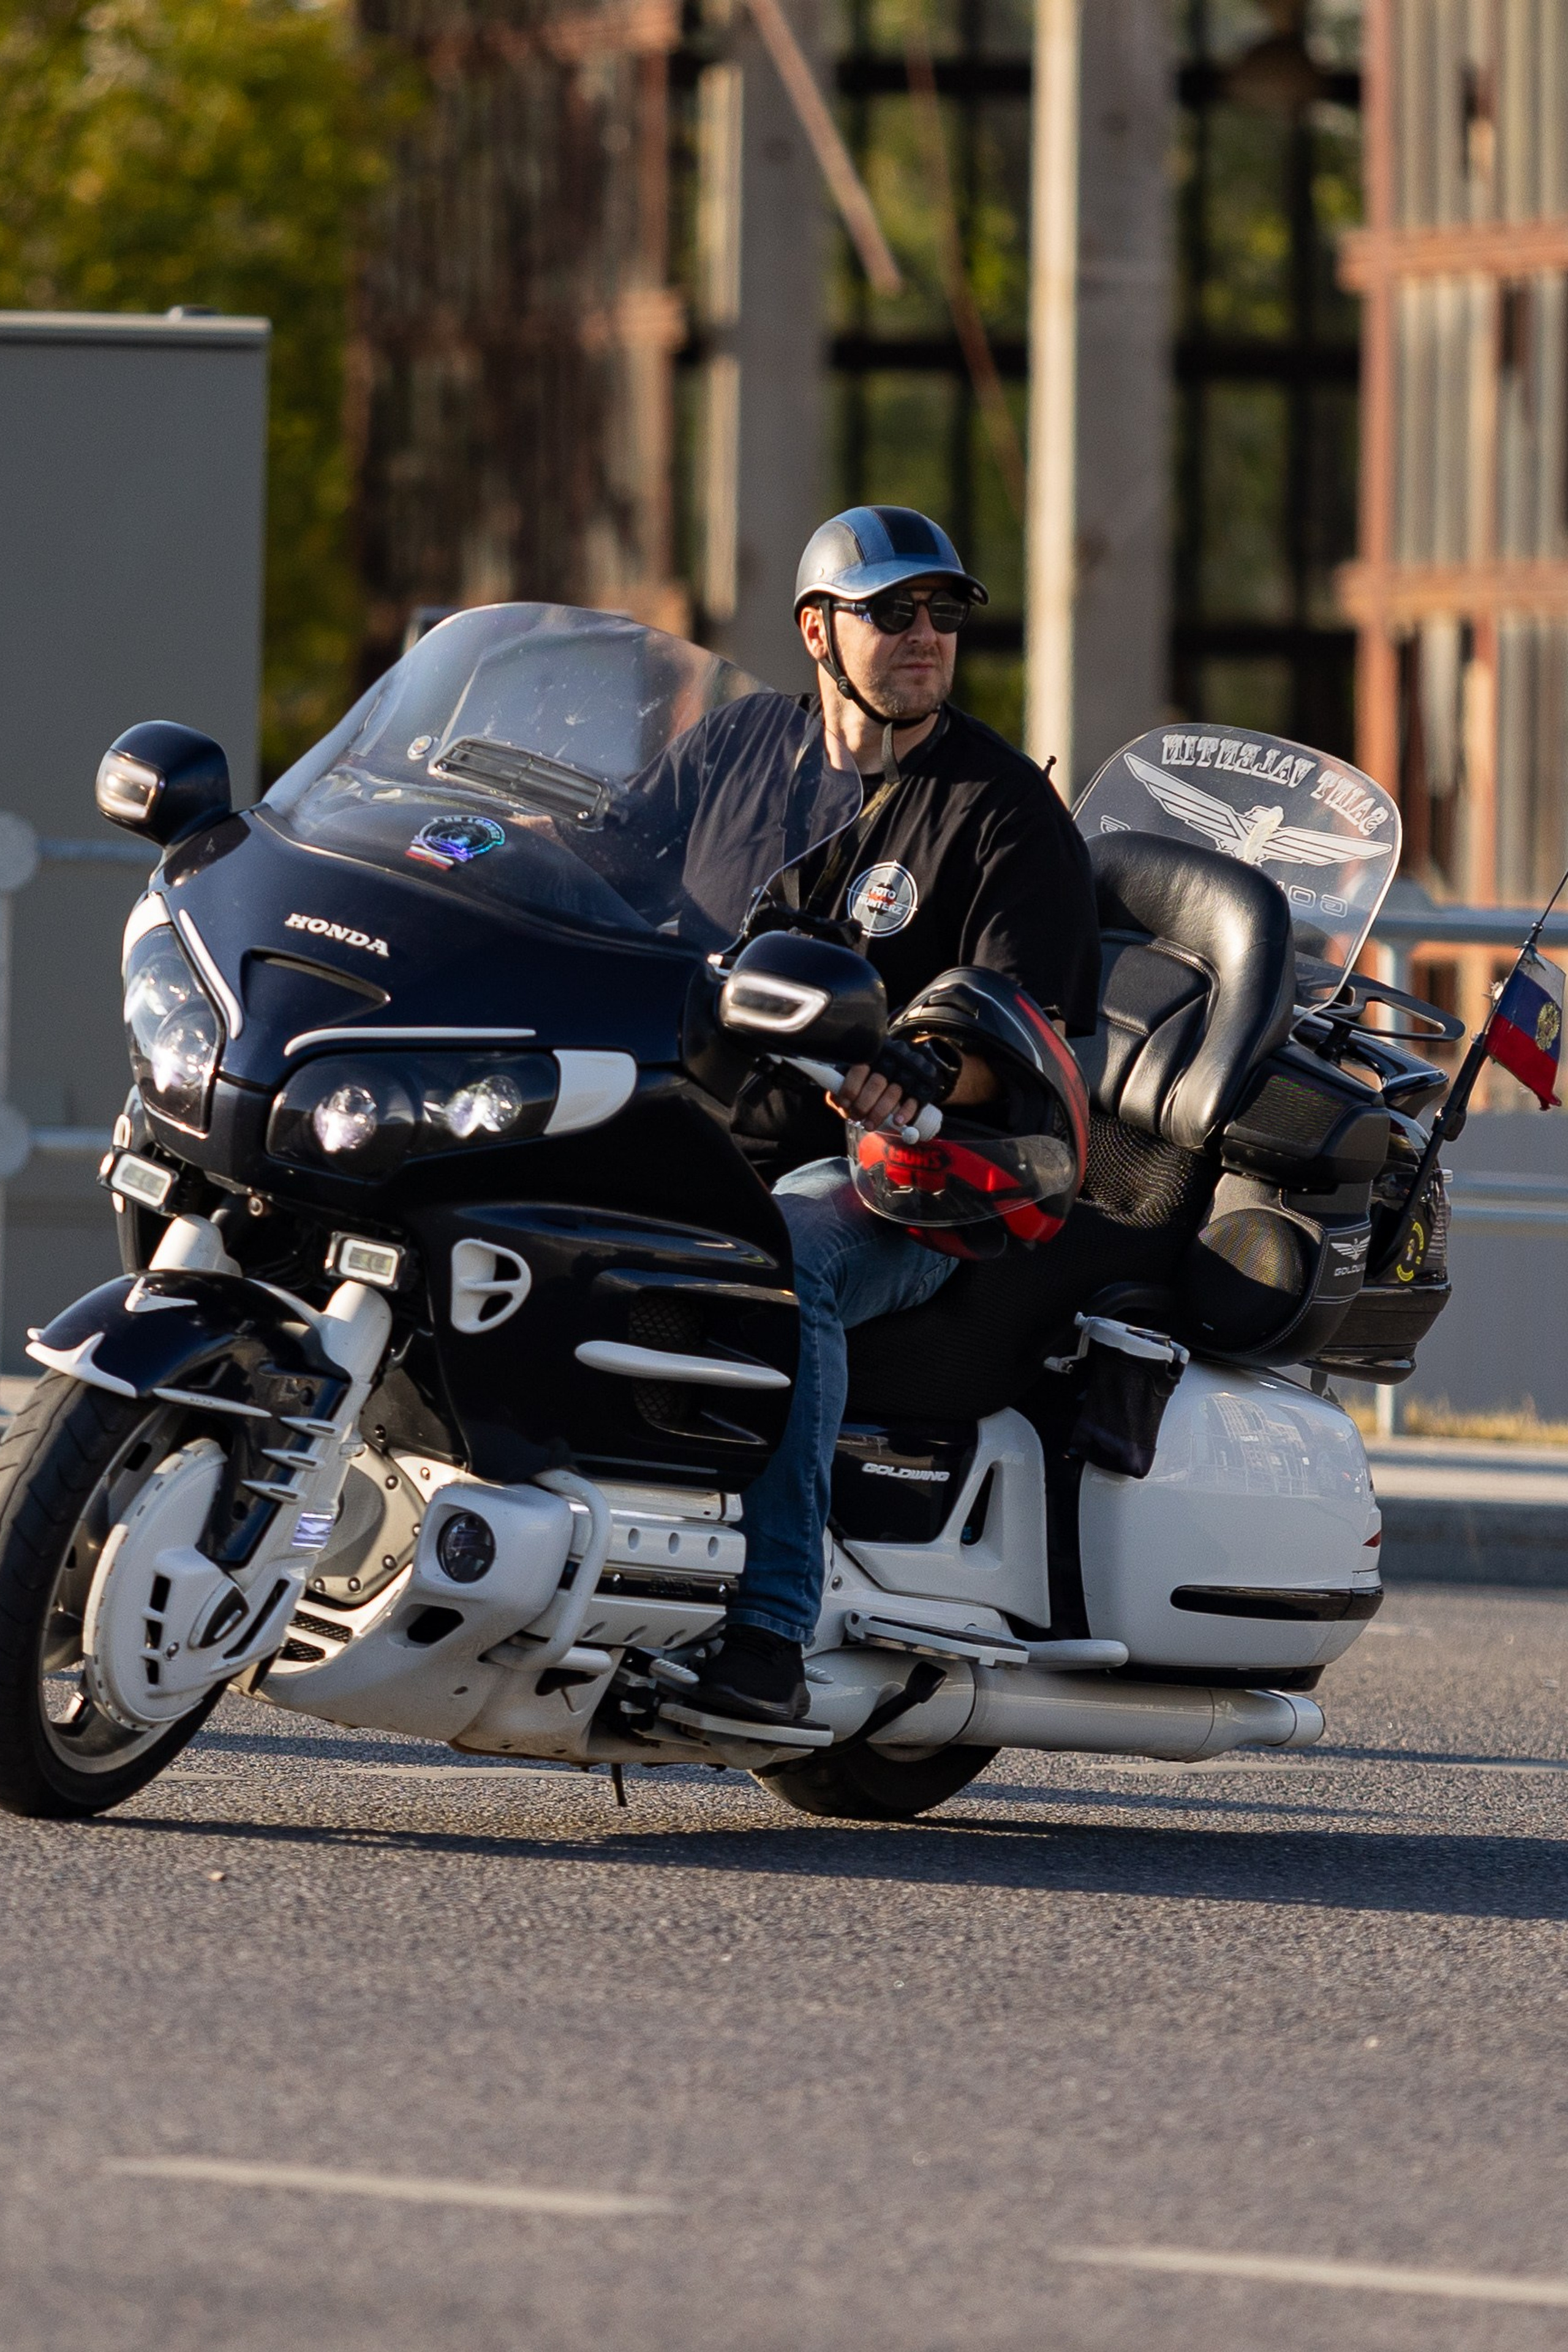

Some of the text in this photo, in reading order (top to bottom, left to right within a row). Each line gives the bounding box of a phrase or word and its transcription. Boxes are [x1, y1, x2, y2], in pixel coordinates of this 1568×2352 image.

[871, 886, 896, 899] FOTO
[857, 895, 903, 914] HUNTERZ
[284, 913, 390, 957] HONDA
[862, 1463, 950, 1482] GOLDWING
